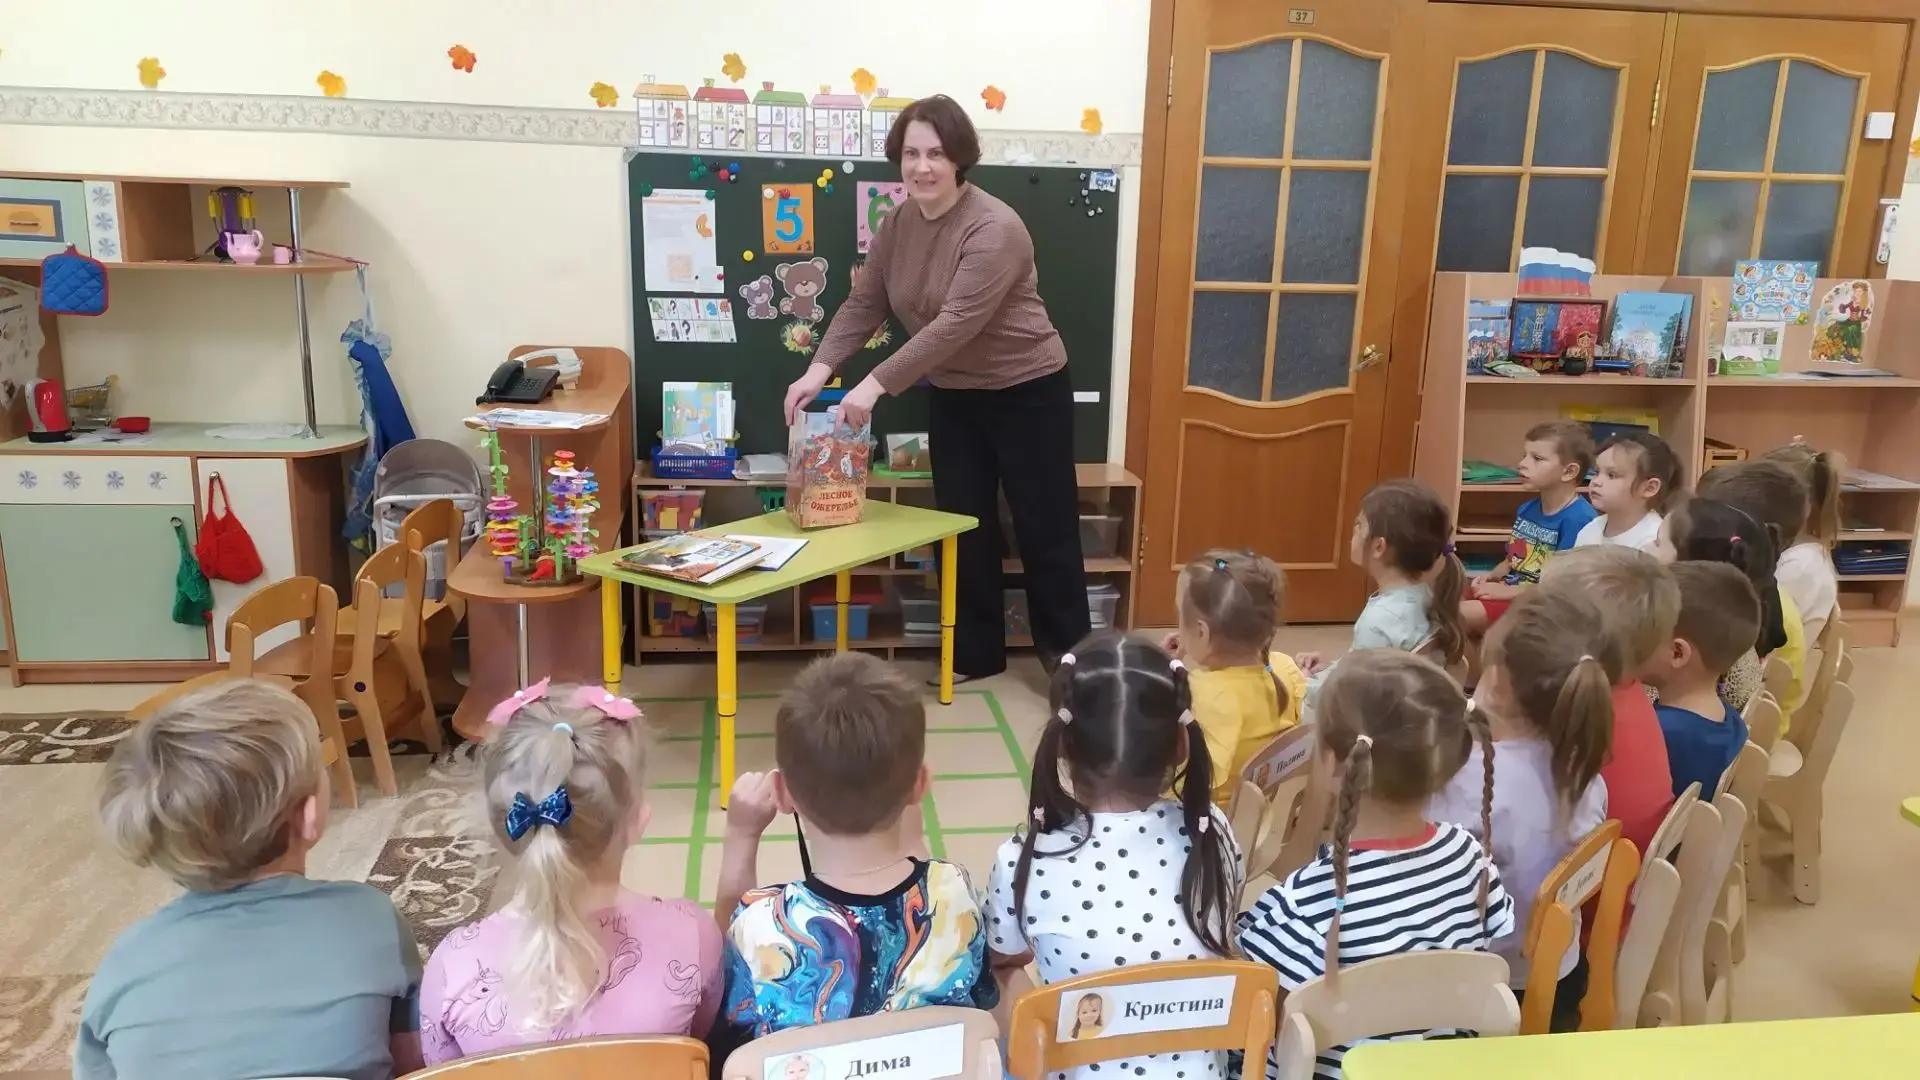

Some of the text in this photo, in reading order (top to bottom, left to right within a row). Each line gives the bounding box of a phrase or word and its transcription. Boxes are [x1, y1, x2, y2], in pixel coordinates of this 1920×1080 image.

[1296, 11, 1308, 21] 37
[775, 197, 804, 243] 5
[819, 490, 853, 500] ЛЕСНОЕ
[810, 498, 858, 512] ОЖЕРЕЛЬЕ
[1124, 997, 1224, 1020] Кристина
[844, 1055, 912, 1080] Дима
